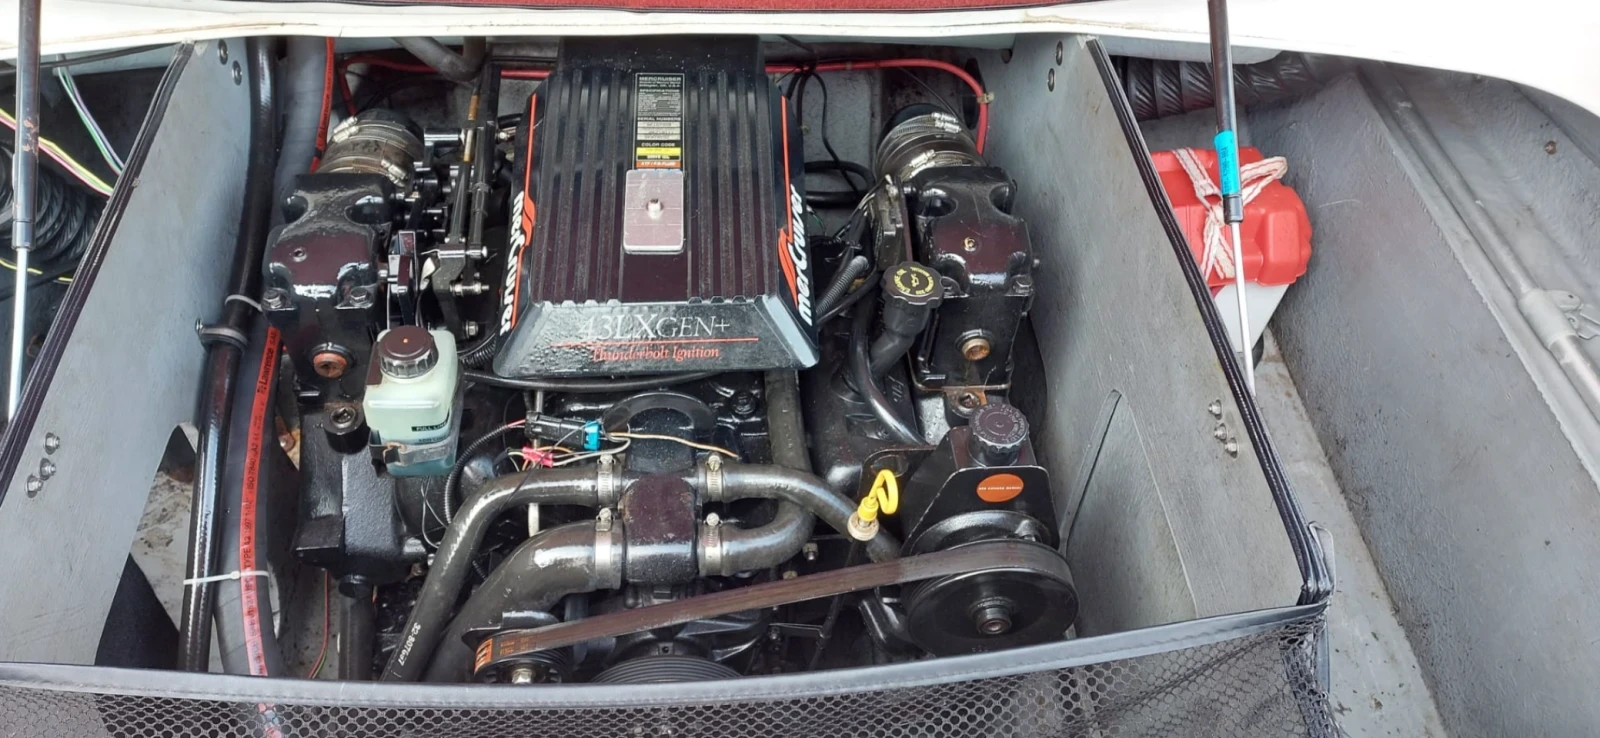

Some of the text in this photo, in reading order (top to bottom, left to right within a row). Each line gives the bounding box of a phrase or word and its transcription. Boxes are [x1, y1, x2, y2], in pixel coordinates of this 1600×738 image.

[592, 345, 719, 362] Thunderbolt Ignition
[259, 348, 275, 387] Lawrence
[246, 477, 256, 491] ISO
[243, 548, 252, 569] TYPE
